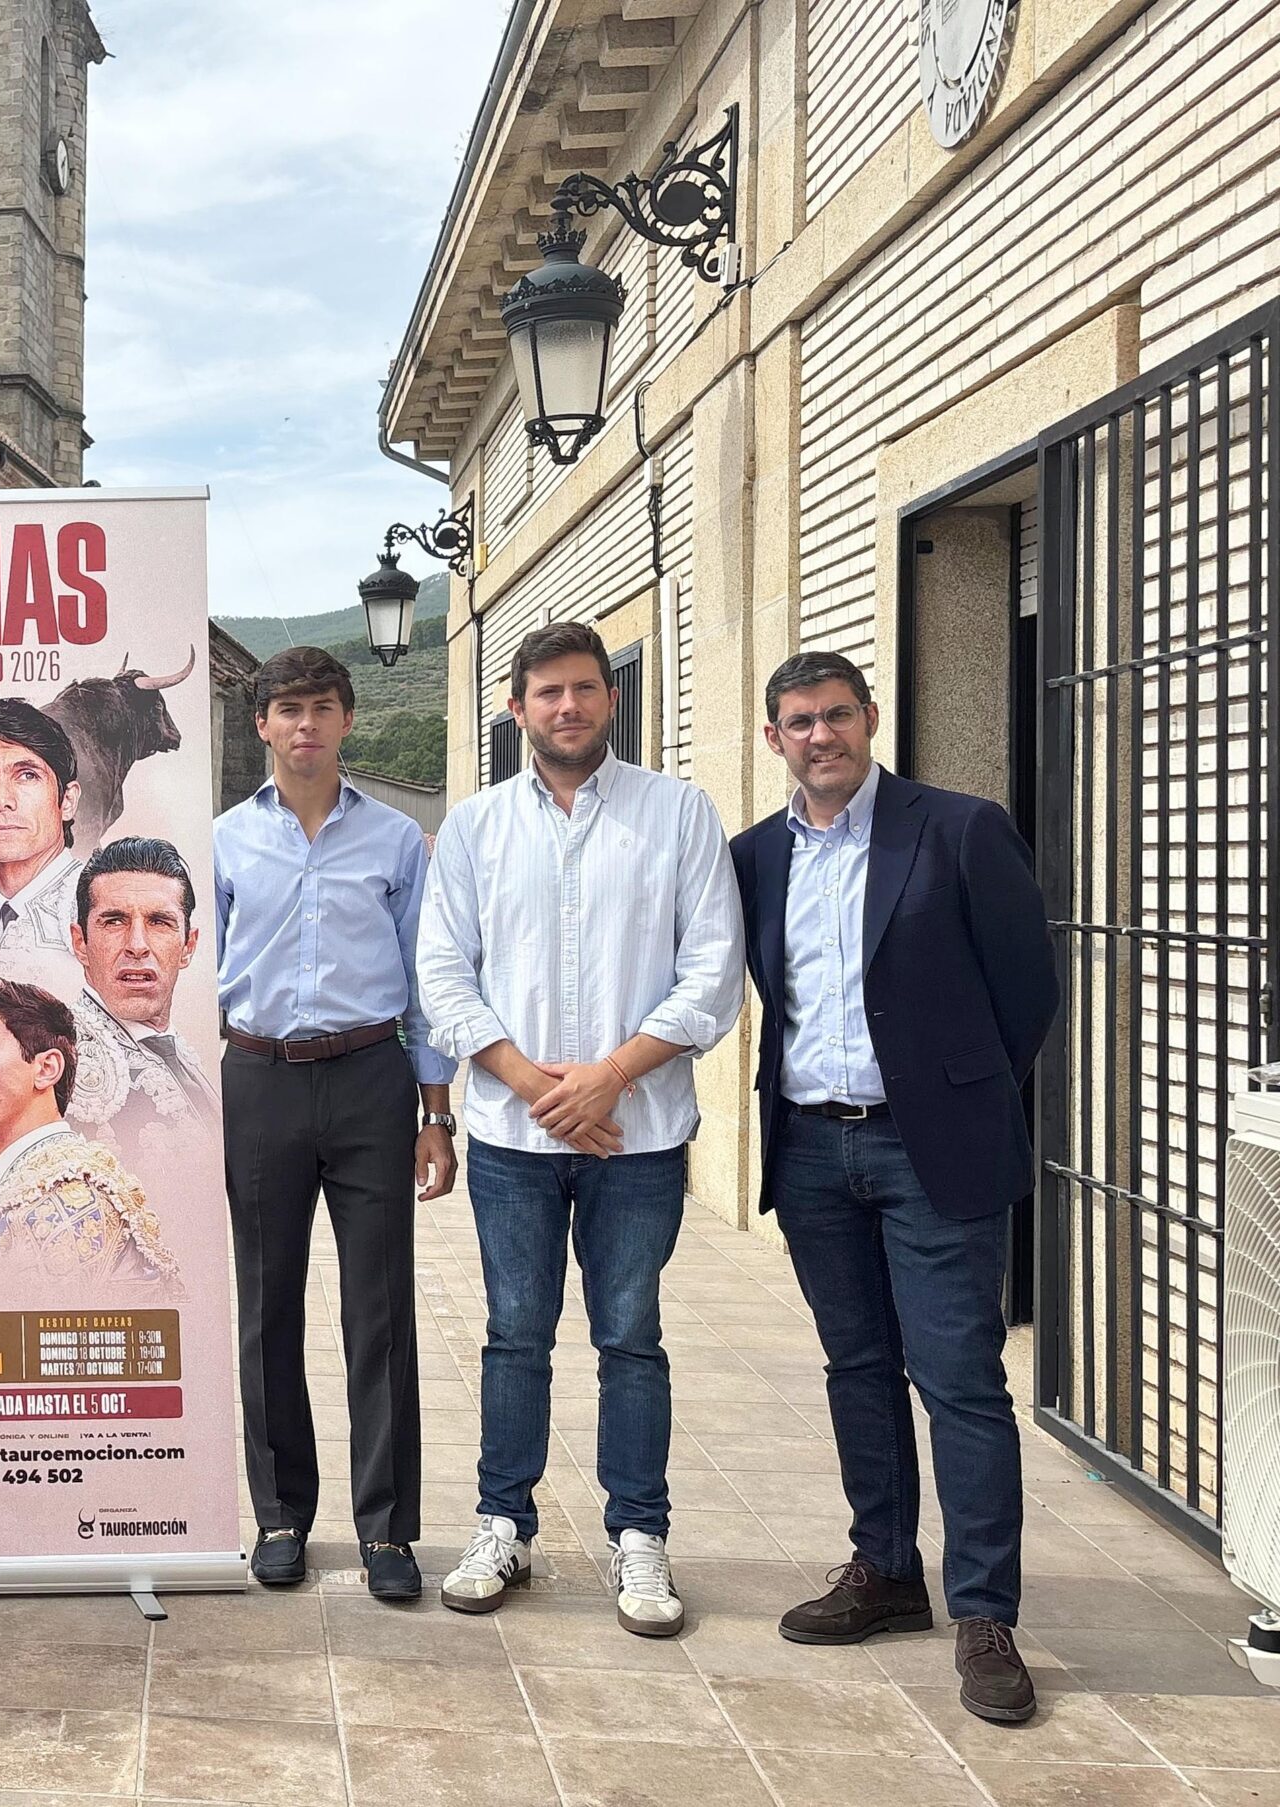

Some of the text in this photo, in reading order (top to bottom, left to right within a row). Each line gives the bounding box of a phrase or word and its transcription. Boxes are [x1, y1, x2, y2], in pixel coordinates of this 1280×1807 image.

[946, 0, 1004, 136] ENDIADA
[11, 650, 61, 682] 2026
[39, 1317, 132, 1328] RESTO DE CAPEAS
[39, 1332, 77, 1346] DOMINGO
[78, 1331, 88, 1345] 18
[88, 1331, 126, 1345] OCTUBRE
[40, 1347, 78, 1361] DOMINGO
[78, 1346, 88, 1360] 18
[89, 1346, 127, 1360] OCTUBRE
[40, 1360, 163, 1376] MARTES 20 OCTUBRE 17:00H
[27, 1394, 70, 1415] HASTA
[73, 1393, 87, 1414] EL
[91, 1393, 99, 1414] 5
[101, 1393, 132, 1414] OCT.
[2, 1469, 42, 1484] 494
[47, 1468, 83, 1484] 502
[99, 1517, 187, 1536] TAUROEMOCIÓN
